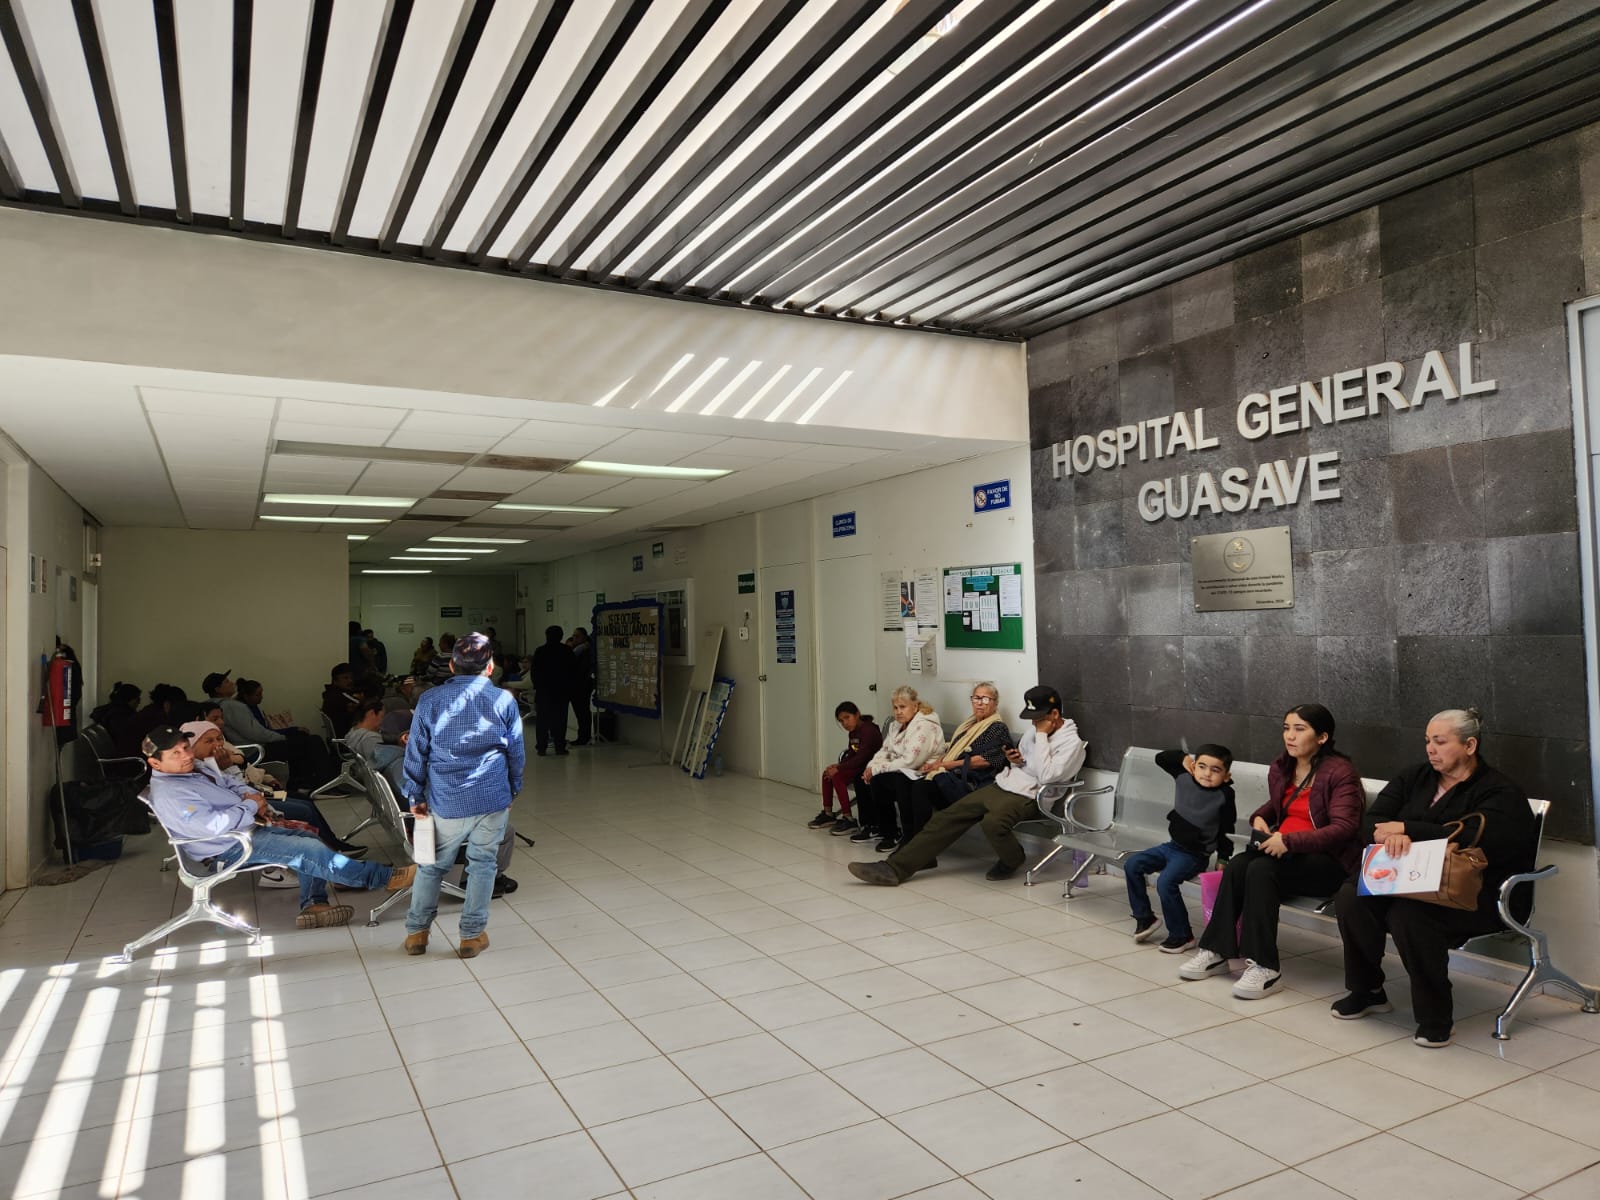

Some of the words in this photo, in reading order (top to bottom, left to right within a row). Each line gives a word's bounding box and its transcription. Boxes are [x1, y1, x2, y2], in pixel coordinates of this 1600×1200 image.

[1052, 408, 1219, 479] HOSPITAL
[1237, 342, 1496, 439] GENERAL
[1138, 451, 1341, 521] GUASAVE
